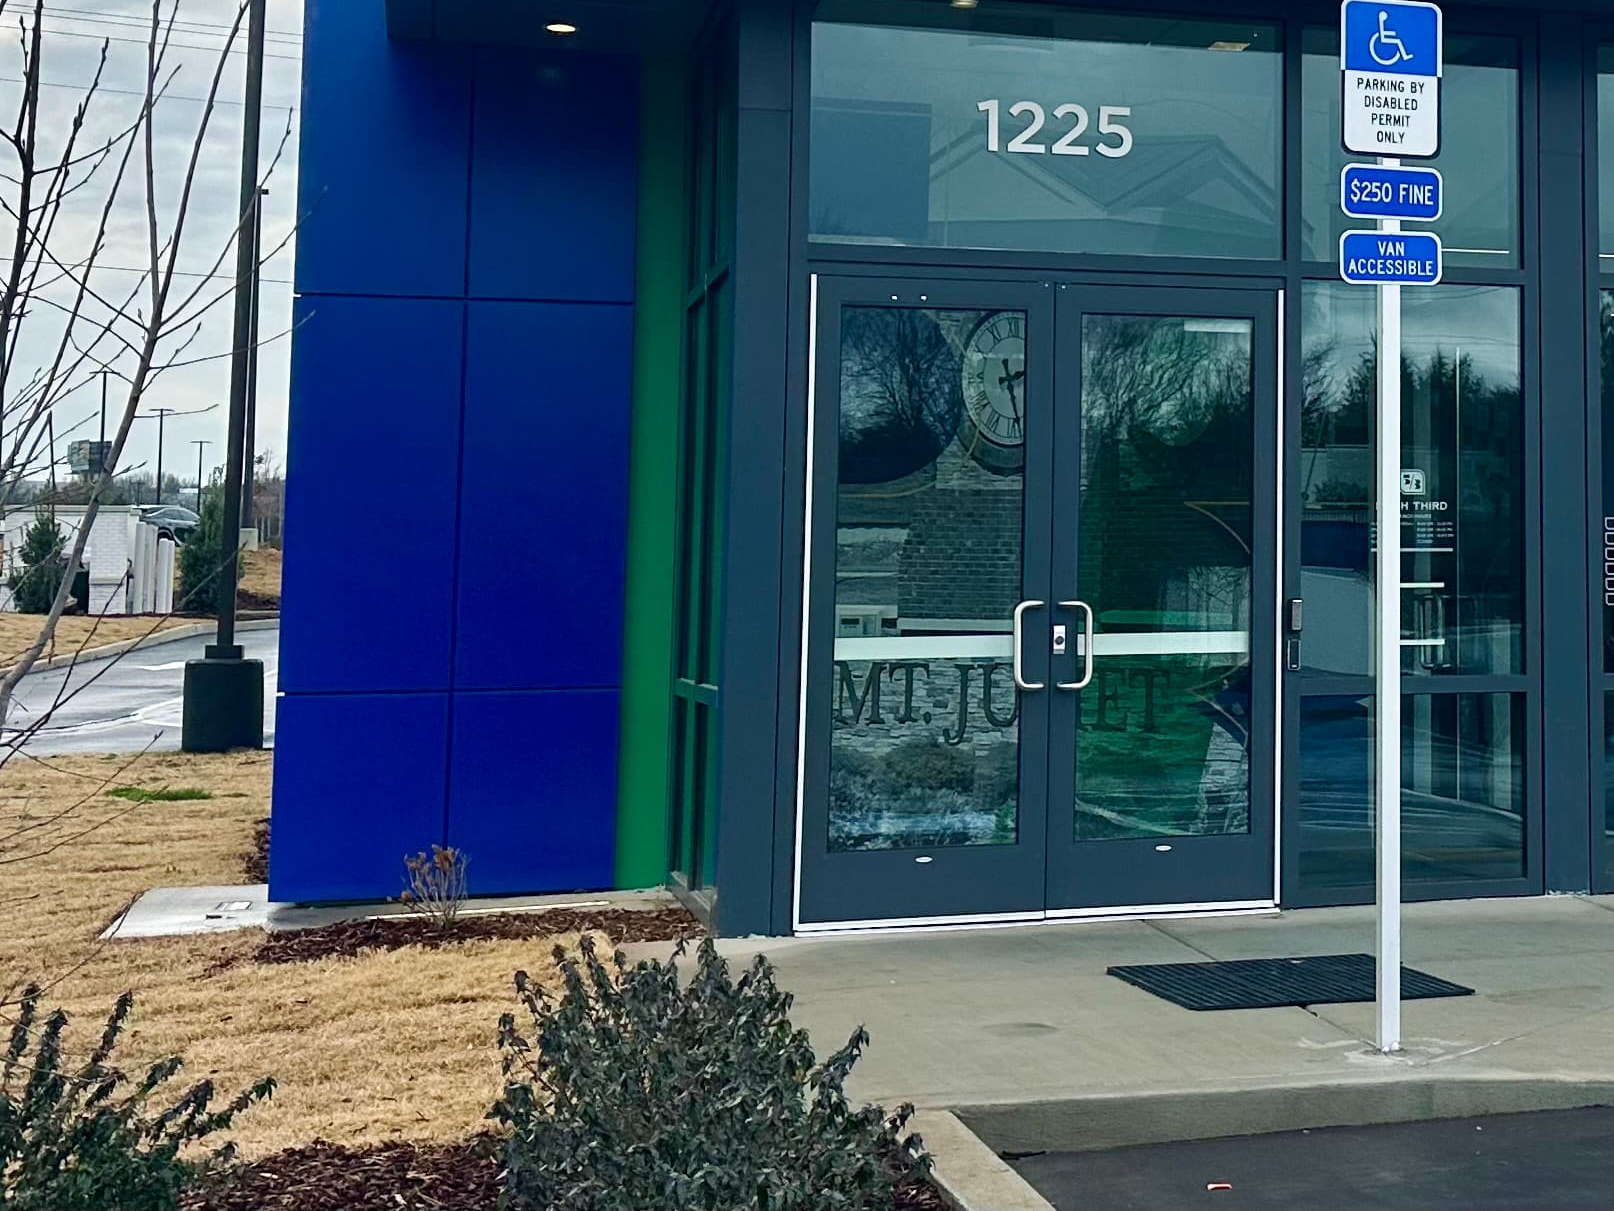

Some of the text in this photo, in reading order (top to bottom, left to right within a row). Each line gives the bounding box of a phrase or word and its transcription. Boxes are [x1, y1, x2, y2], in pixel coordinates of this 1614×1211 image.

[1357, 77, 1425, 94] PARKING BY
[1364, 95, 1418, 111] DISABLED
[1371, 112, 1410, 127] PERMIT
[976, 99, 1133, 158] 1225
[1376, 130, 1405, 145] ONLY
[1350, 178, 1434, 205] $250 FINE
[1377, 240, 1405, 257] VAN
[1347, 258, 1434, 276] ACCESSIBLE
